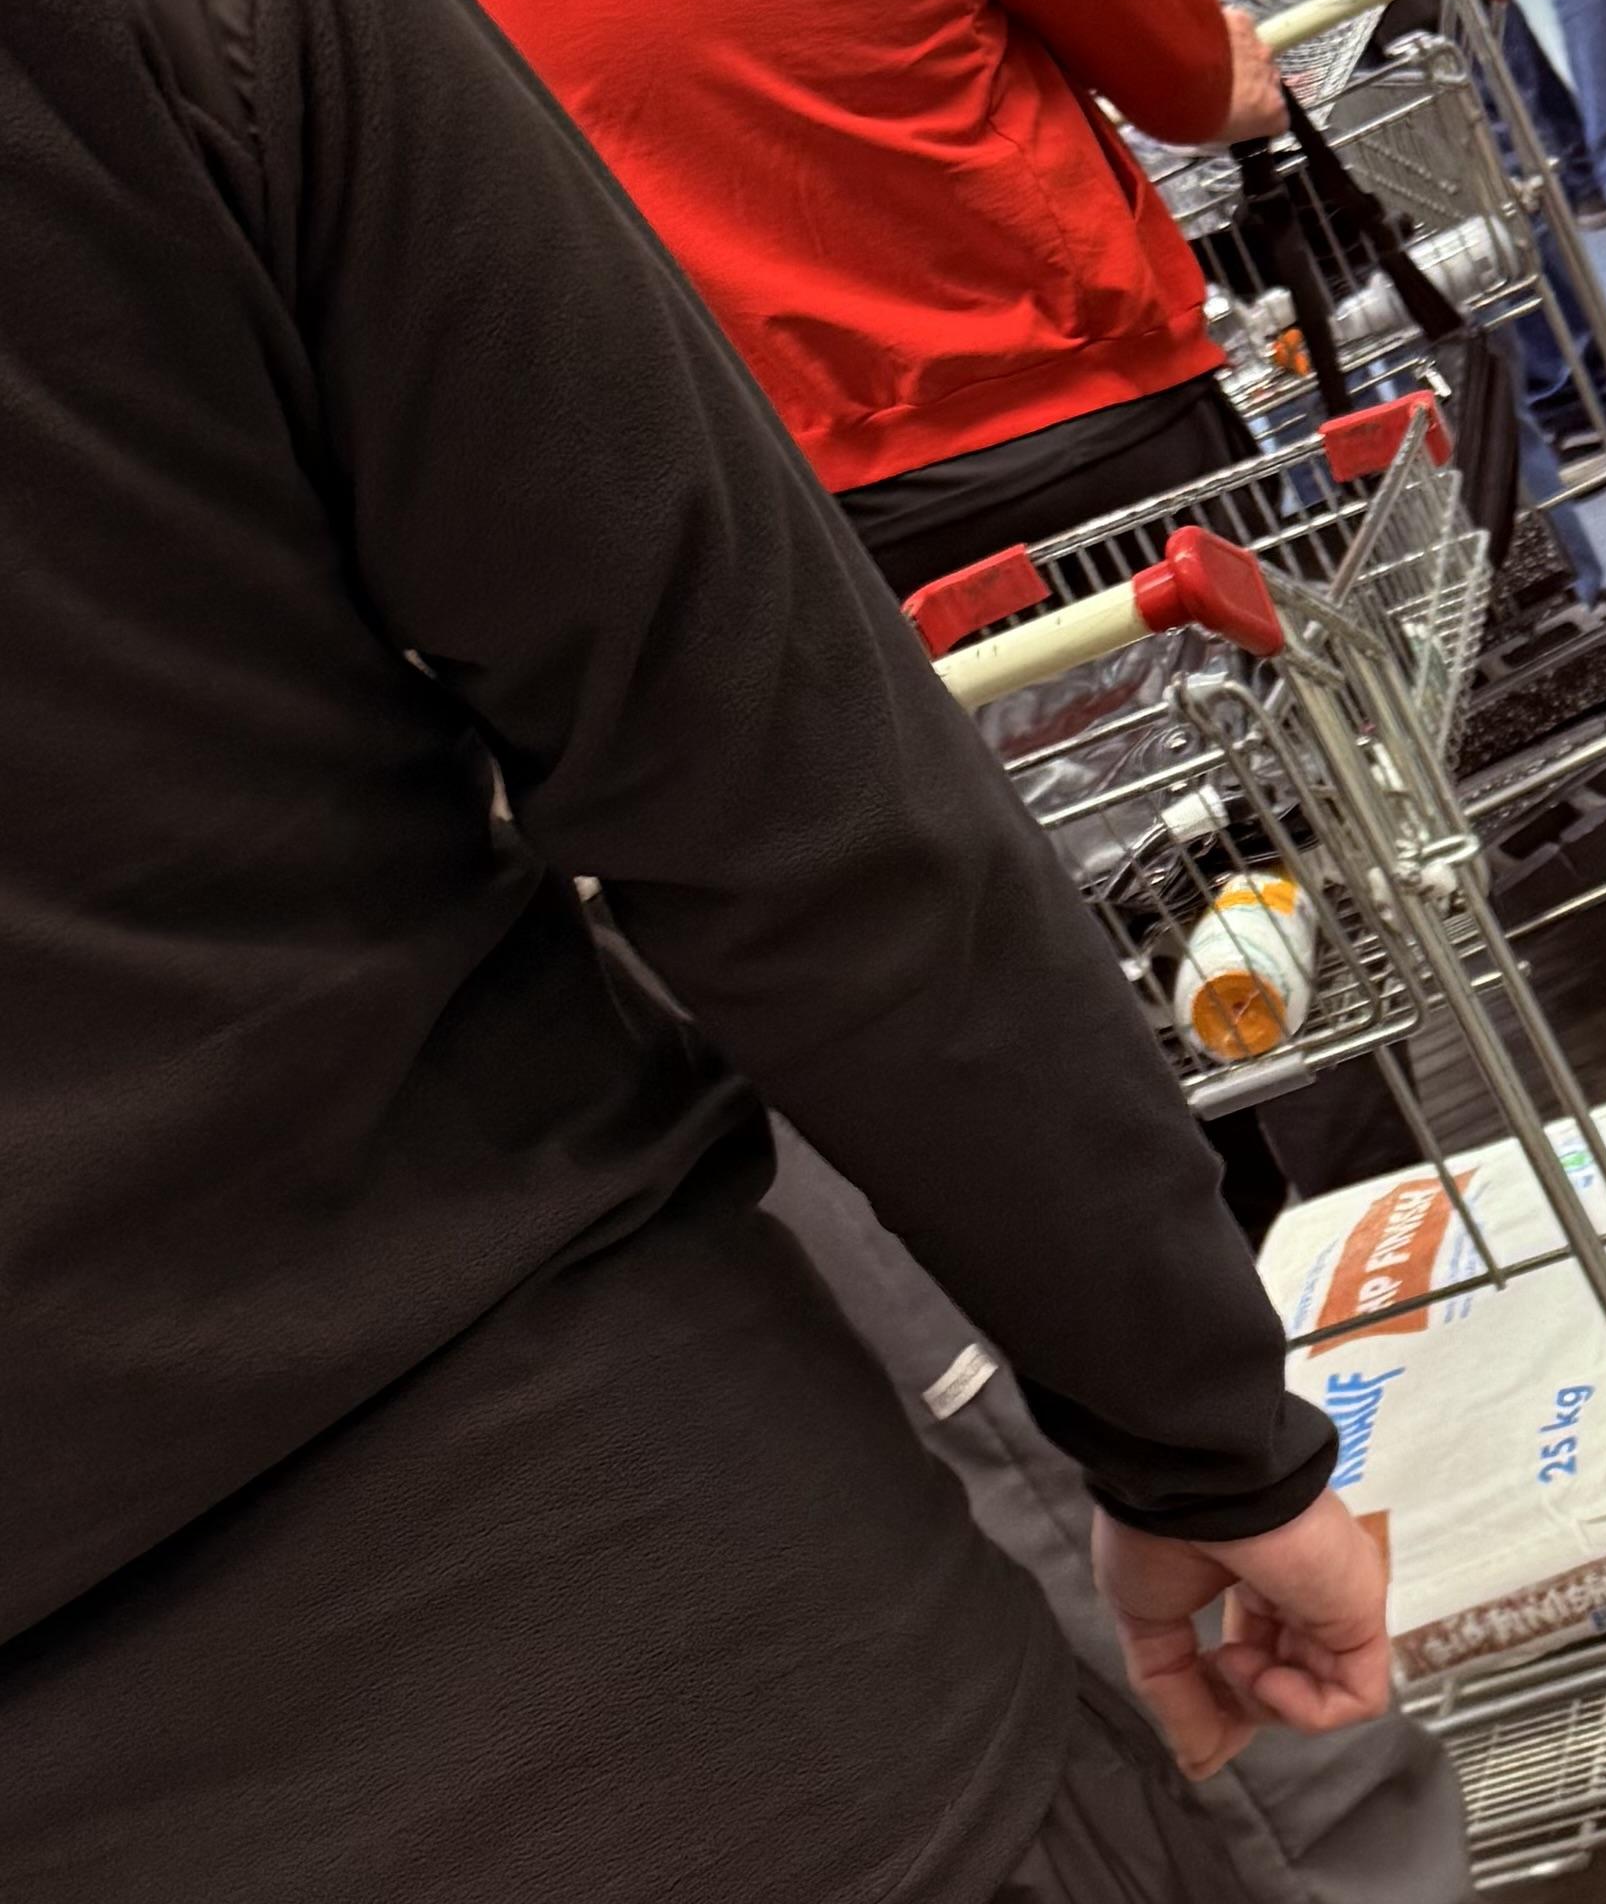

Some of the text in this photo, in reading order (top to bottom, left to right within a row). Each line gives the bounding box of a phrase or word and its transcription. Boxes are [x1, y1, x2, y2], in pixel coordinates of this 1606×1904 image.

[1365, 1188, 1436, 1273] FINISH
[1326, 1366, 1406, 1492] KNAUF
[1537, 1383, 1596, 1485] 25 kg
